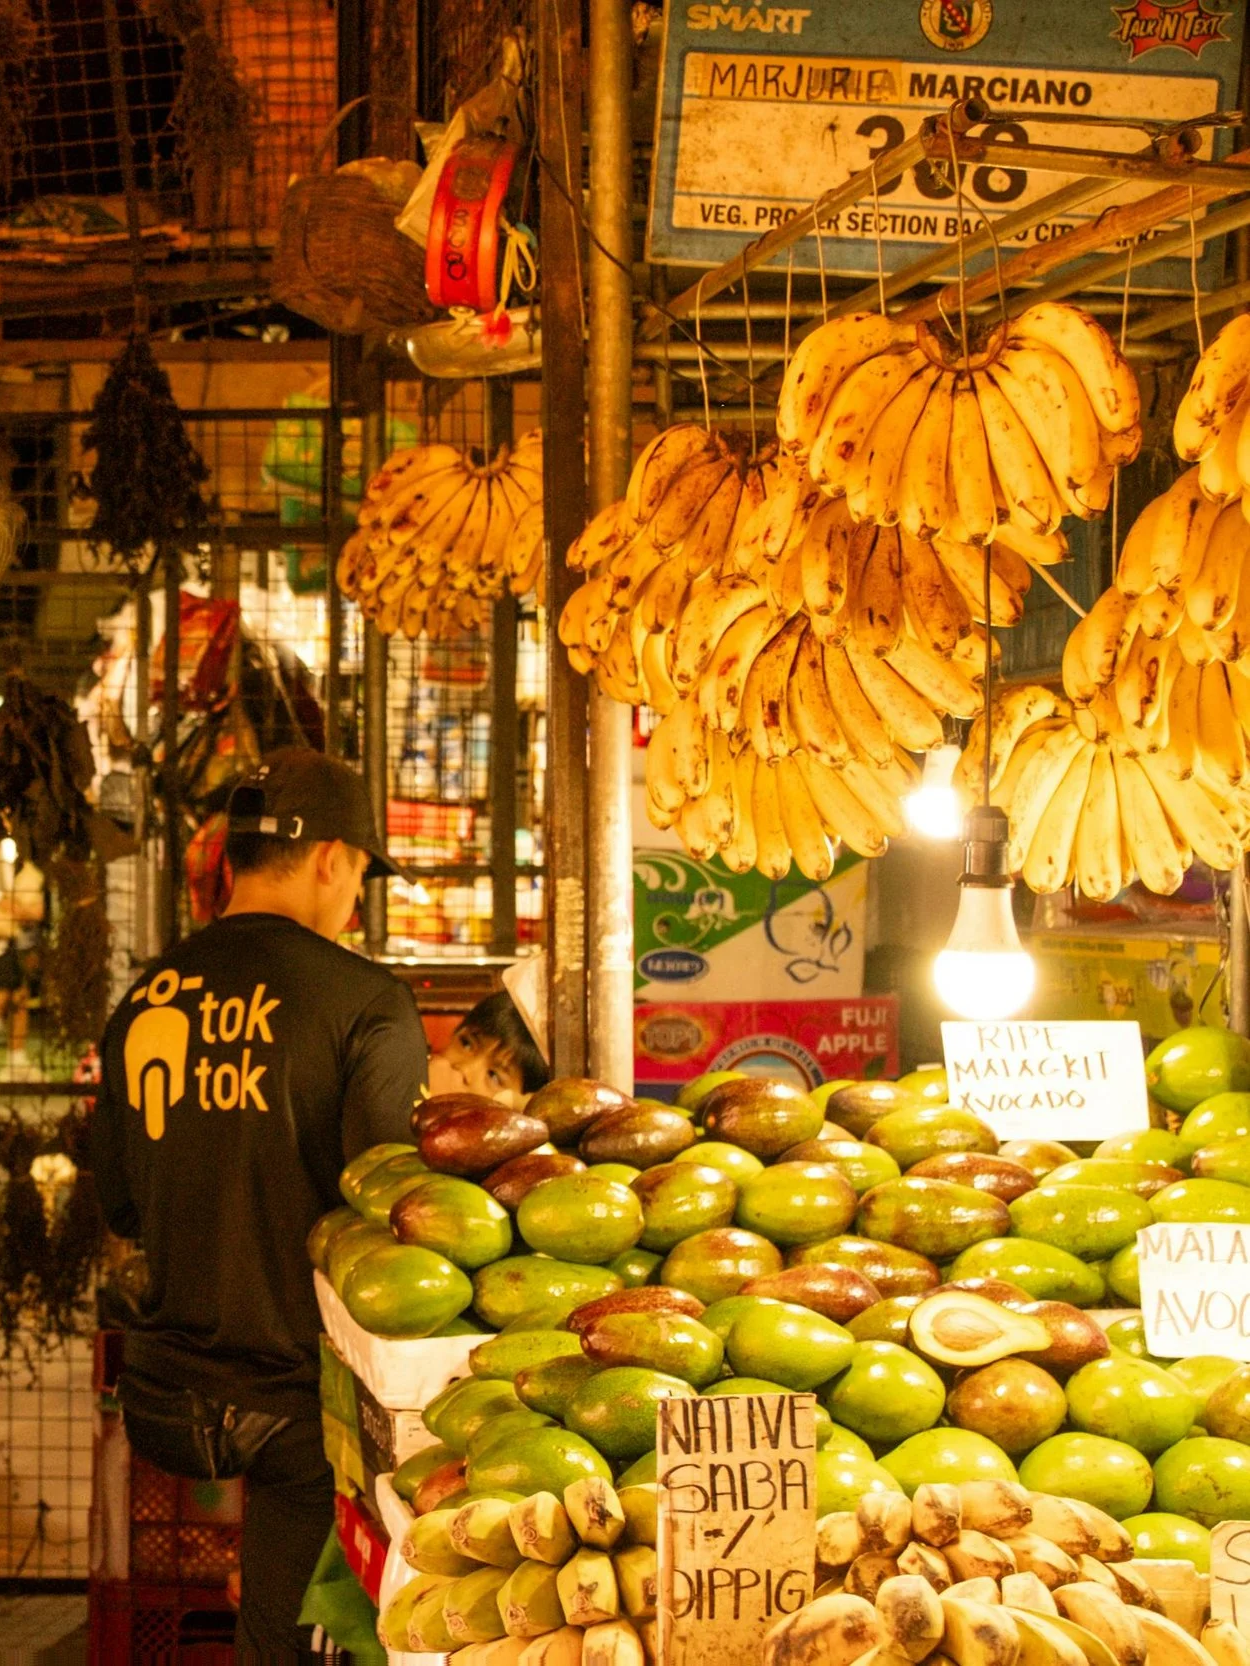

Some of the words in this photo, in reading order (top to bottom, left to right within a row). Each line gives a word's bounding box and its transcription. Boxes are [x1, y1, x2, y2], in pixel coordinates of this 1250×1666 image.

[686, 4, 812, 34] SMART
[1120, 11, 1157, 41] TALK
[1181, 10, 1219, 40] TEXT
[908, 72, 1092, 107] MARCIANO
[700, 203, 748, 226] VEG.
[754, 206, 840, 232] PROR
[846, 211, 937, 237] SECTION
[1034, 222, 1075, 243] CIT
[198, 983, 281, 1045] tok
[841, 1006, 888, 1027] FUJI
[816, 1033, 888, 1054] APPLE
[977, 1025, 1065, 1051] RIPE
[194, 1048, 269, 1112] tok
[661, 1394, 815, 1455] NATIVE
[661, 1459, 809, 1514] SABA
